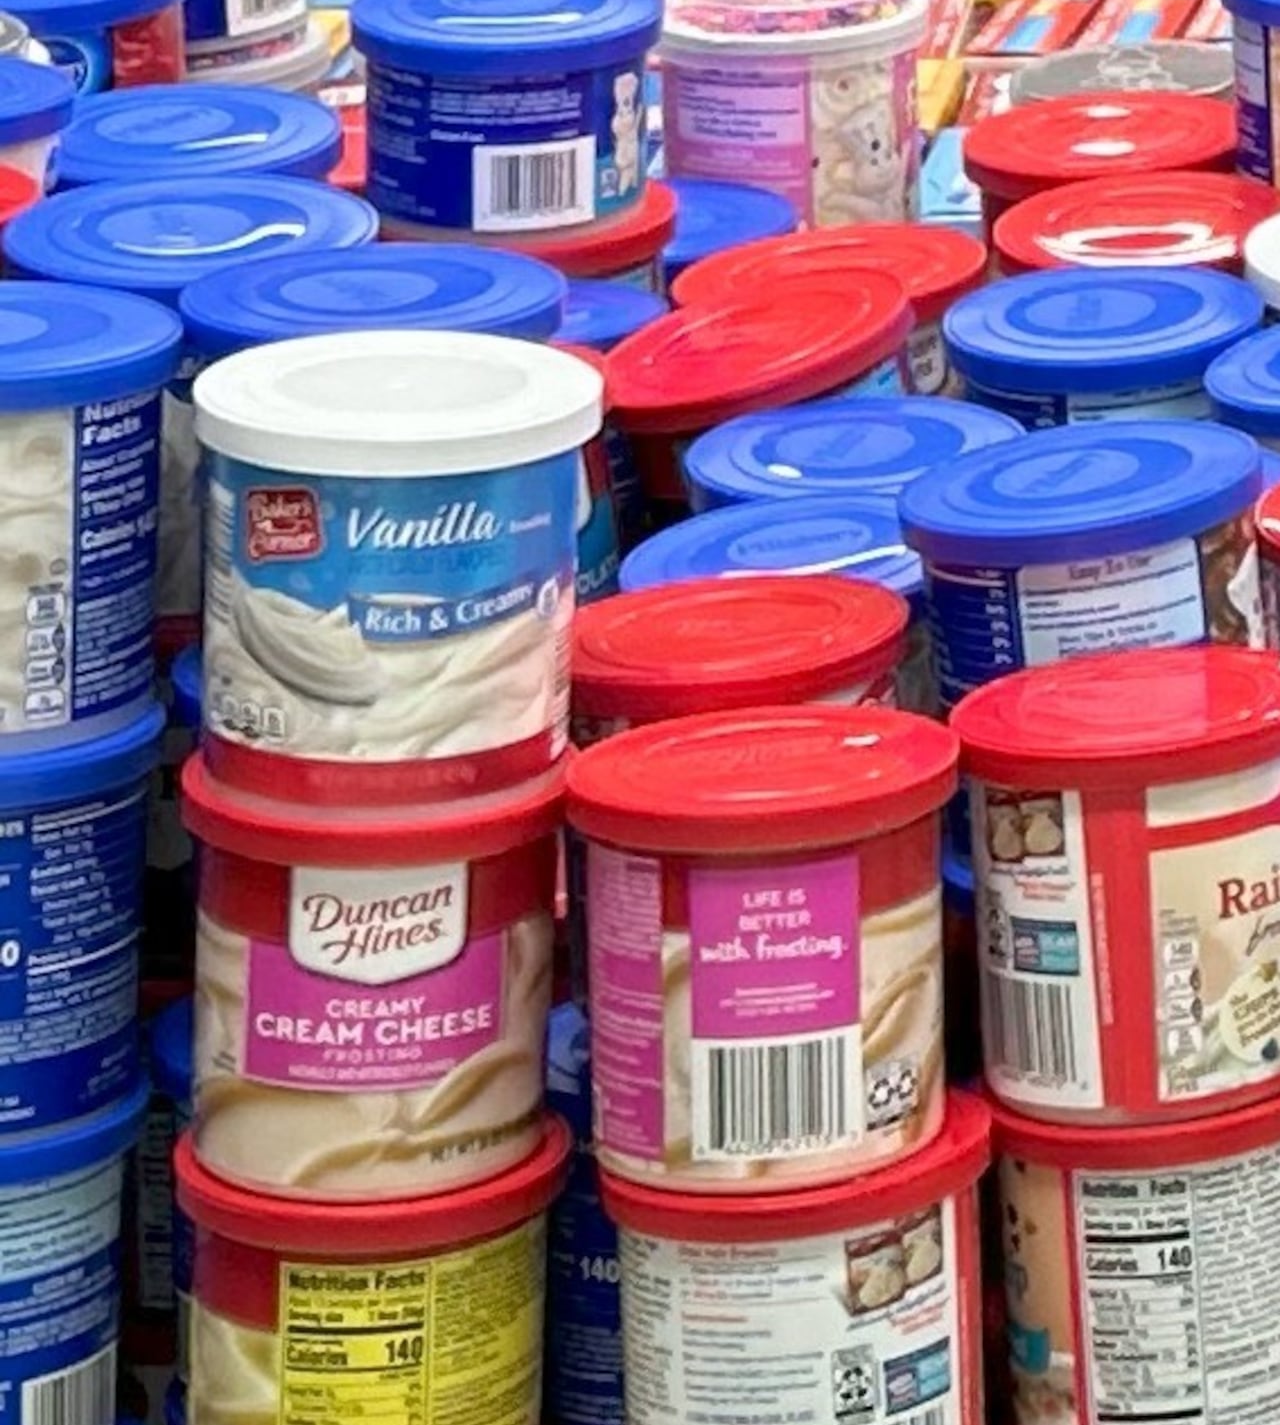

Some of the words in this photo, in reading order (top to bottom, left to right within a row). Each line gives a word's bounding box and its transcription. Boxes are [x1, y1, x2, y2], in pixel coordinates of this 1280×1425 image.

[81, 415, 142, 447] Facts
[347, 500, 500, 551] Vanilla
[364, 606, 422, 633] Rich
[428, 606, 450, 631] &
[454, 581, 534, 625] Creamy
[302, 884, 453, 933] Duncan
[742, 889, 782, 909] LIFE
[787, 887, 807, 906] IS
[738, 909, 811, 932] BETTER
[320, 916, 445, 966] Hines
[701, 936, 751, 963] with
[325, 995, 426, 1019] CREAMY
[256, 1012, 365, 1046] CREAM
[374, 1004, 493, 1046] CHEESE
[1150, 1179, 1187, 1196] Facts
[580, 1255, 621, 1284] 140
[1086, 1255, 1139, 1273] Calories
[1158, 1245, 1193, 1272] 140
[288, 1272, 369, 1292] Nutrition
[374, 1269, 426, 1291] Facts
[286, 1344, 349, 1366] Calories
[384, 1335, 424, 1365] 140
